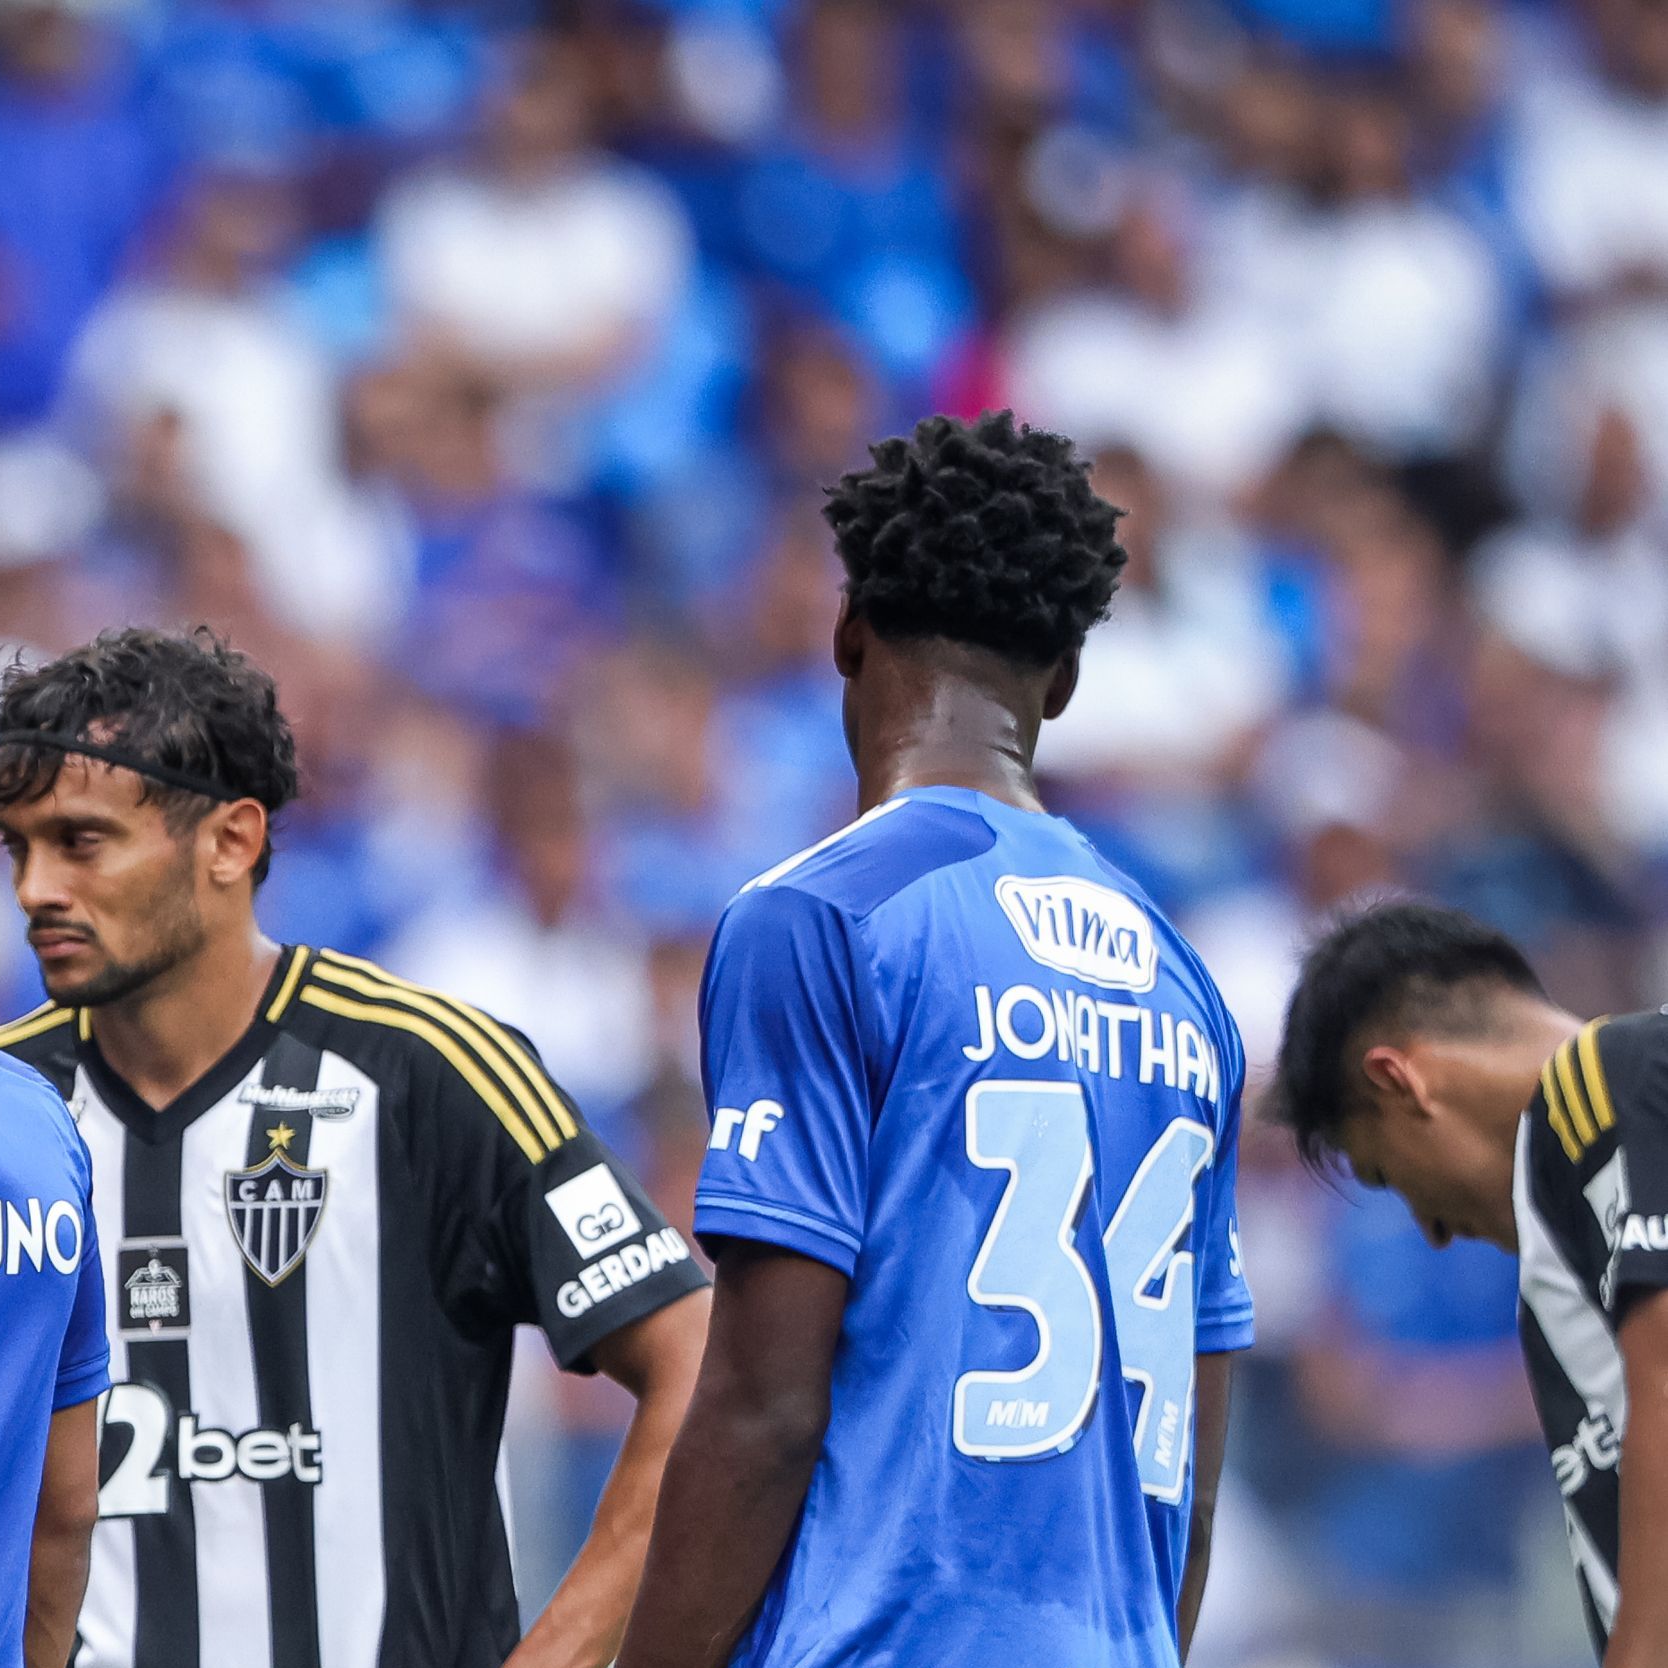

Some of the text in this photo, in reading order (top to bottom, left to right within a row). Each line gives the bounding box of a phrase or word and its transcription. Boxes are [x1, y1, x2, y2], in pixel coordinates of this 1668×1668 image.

[1014, 891, 1141, 969] Vilma
[239, 1180, 315, 1202] CAM
[556, 1226, 690, 1319] GERDAU
[954, 1080, 1215, 1507] 34
